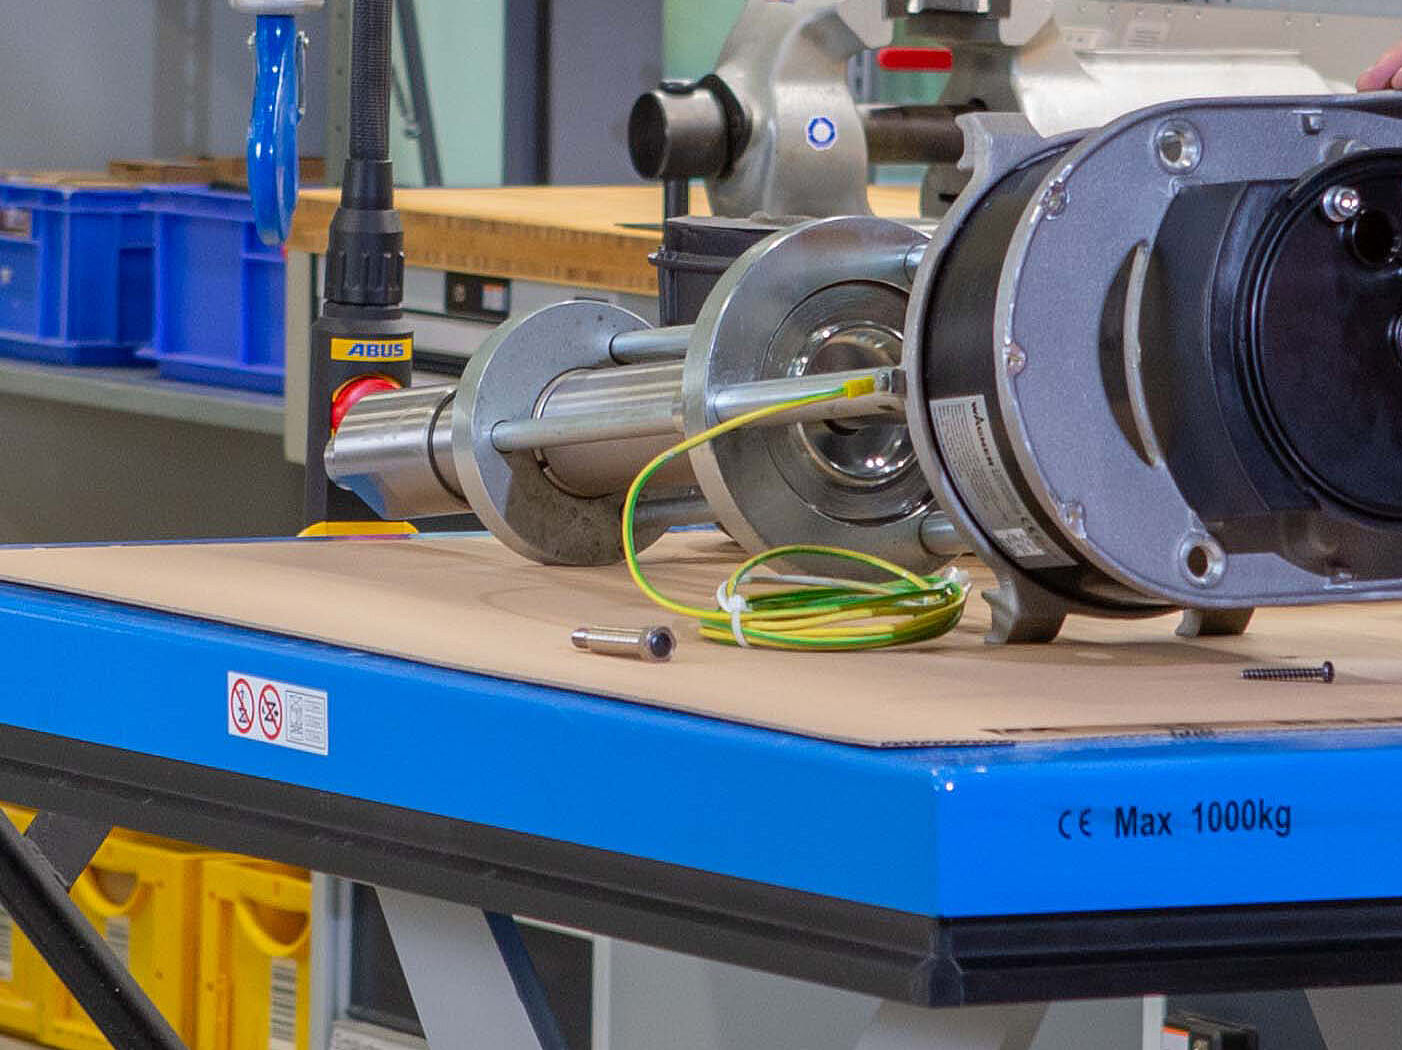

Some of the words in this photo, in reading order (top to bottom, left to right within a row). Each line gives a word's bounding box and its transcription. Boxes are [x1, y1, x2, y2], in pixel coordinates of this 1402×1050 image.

[348, 343, 404, 357] ABUS
[1115, 806, 1173, 839] Max
[1192, 798, 1291, 837] 1000kg
